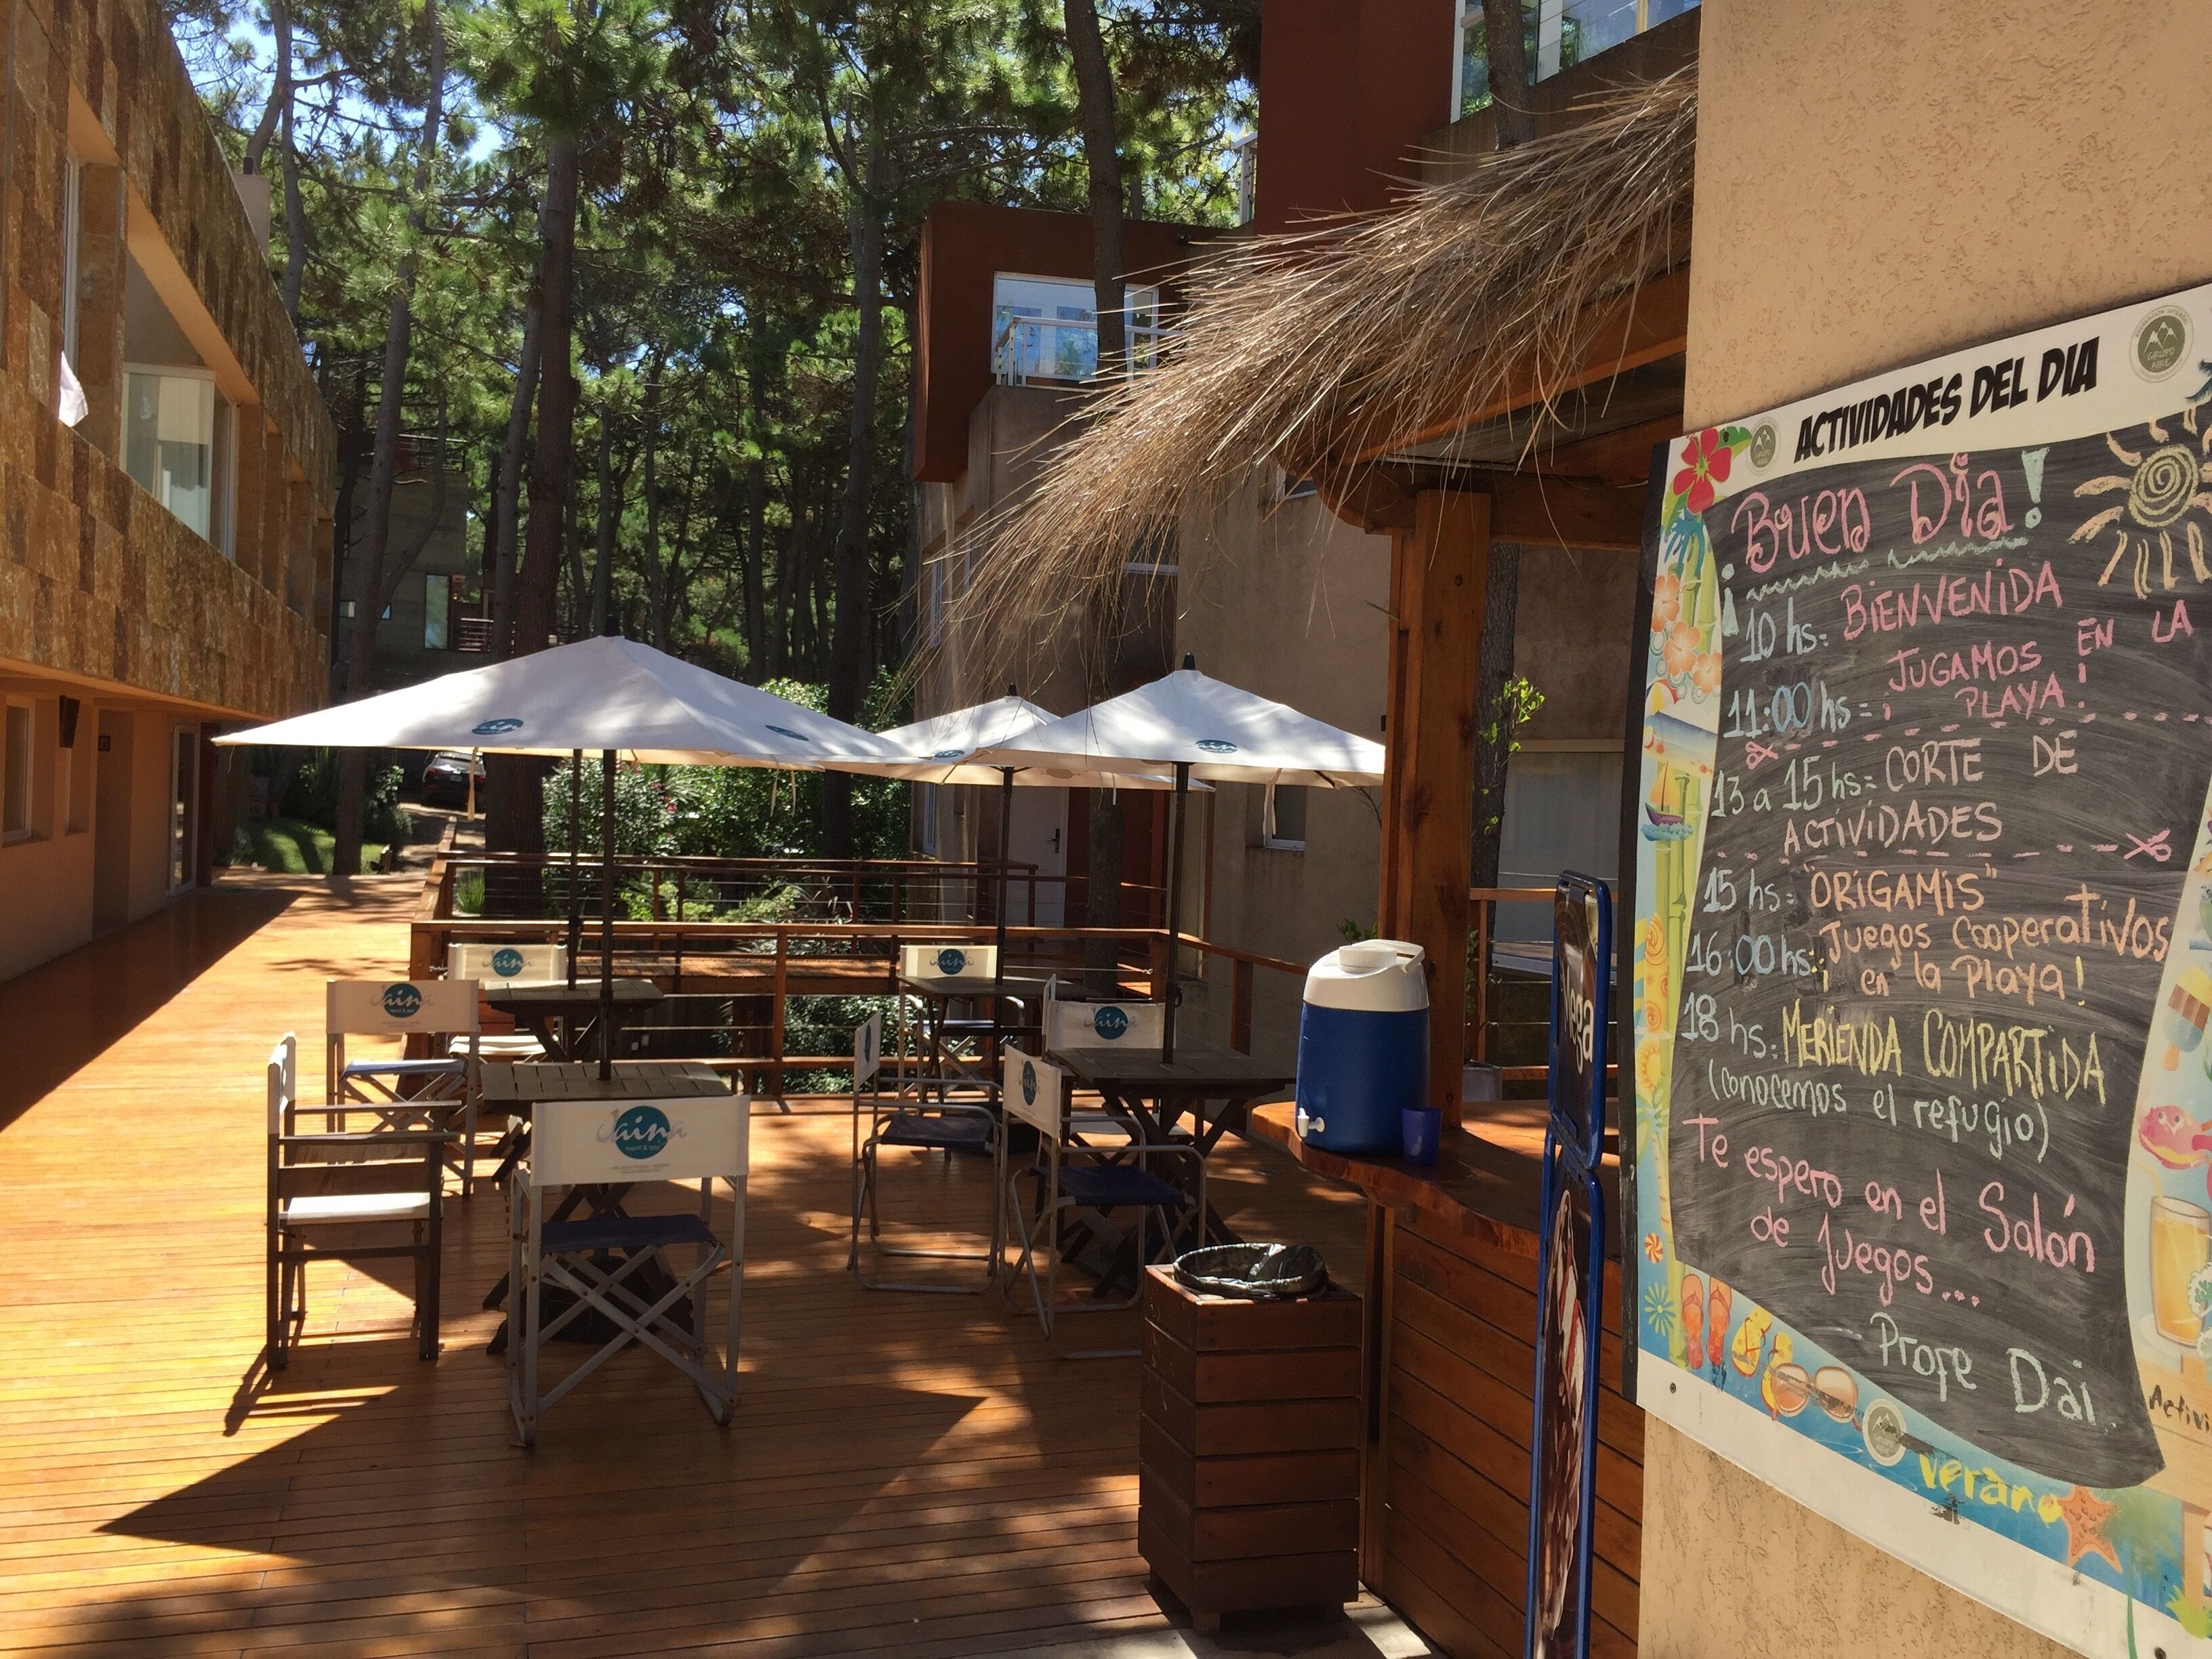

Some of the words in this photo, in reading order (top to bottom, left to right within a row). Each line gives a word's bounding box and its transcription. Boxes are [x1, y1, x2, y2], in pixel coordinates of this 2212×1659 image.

[1794, 372, 1963, 464] ACTIVIDADES
[1969, 356, 2028, 419] DEL
[2036, 335, 2100, 403] DIA
[1740, 607, 1776, 663] 10
[1886, 639, 2043, 692] JUGAMOS
[2076, 617, 2114, 657] EN
[2152, 598, 2194, 643] LA
[1723, 681, 1812, 739] 11:00
[1711, 769, 1745, 817] 13
[1753, 787, 1772, 812] a
[1782, 755, 1823, 811] 15
[1885, 737, 1984, 792] CORTE
[2033, 729, 2079, 777] DE
[1703, 866, 1737, 913] 15
[1686, 930, 1776, 977] 16:00
[1819, 920, 1932, 972] Juegos
[1860, 968, 1890, 998] en
[1914, 951, 1942, 994] la
[1681, 991, 1721, 1043] 18
[1872, 1082, 1898, 1126] el
[1681, 1112, 1729, 1168] Te
[1744, 1145, 1843, 1209] espero
[1864, 1180, 1903, 1221] en
[1919, 1167, 1946, 1236] el
[1978, 1181, 2096, 1273] Salón
[1749, 1206, 1790, 1248] de
